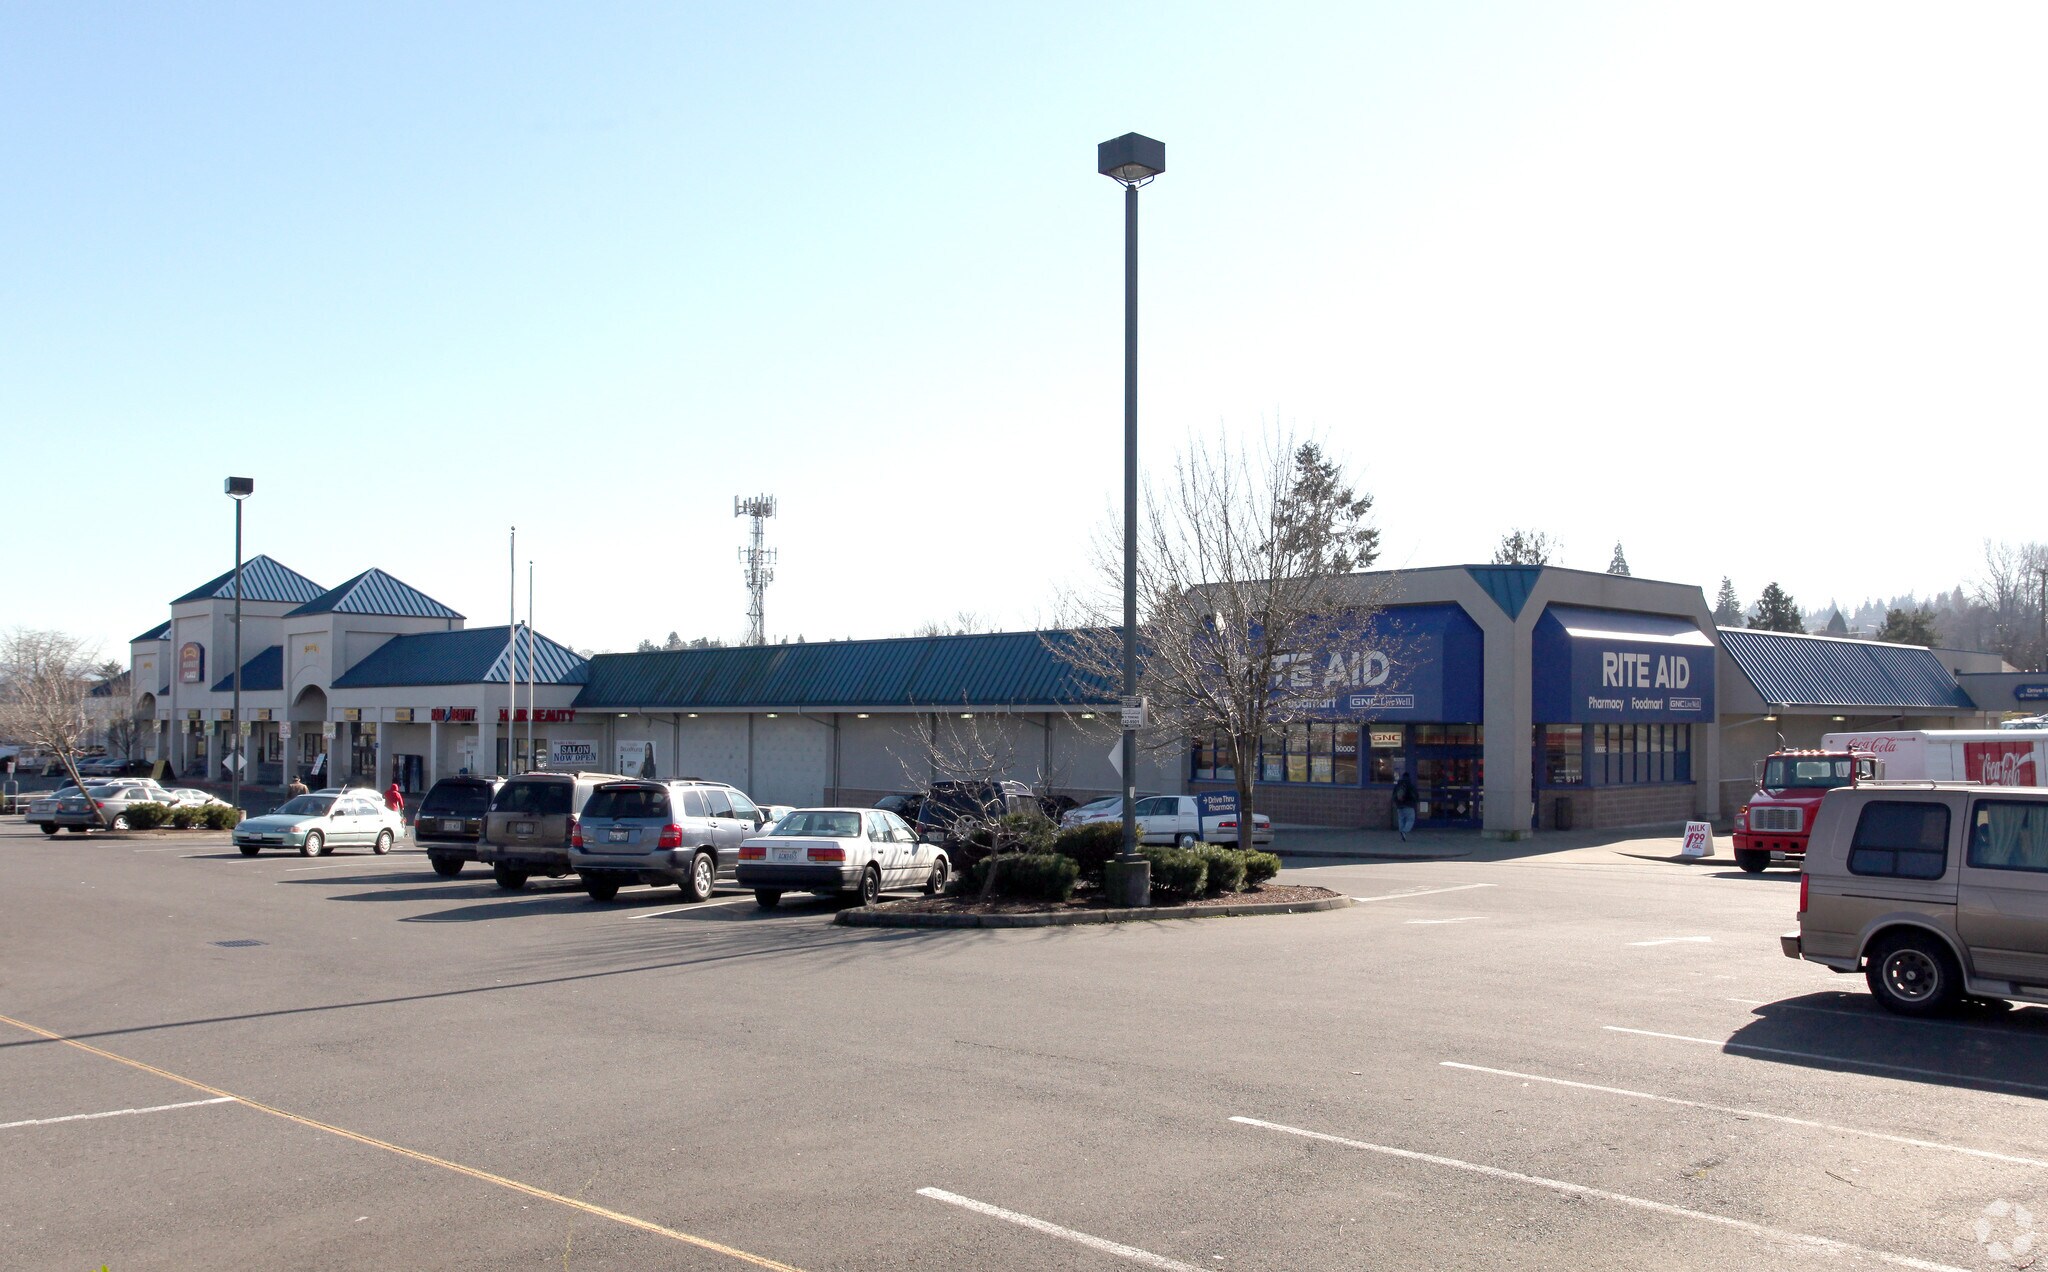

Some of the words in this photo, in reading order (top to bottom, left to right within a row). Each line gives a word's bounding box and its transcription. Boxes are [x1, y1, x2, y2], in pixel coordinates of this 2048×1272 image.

[1322, 650, 1390, 687] AID
[1603, 652, 1650, 688] RITE
[1655, 655, 1690, 689] AID
[1275, 696, 1337, 709] oodmart
[1588, 696, 1624, 712] Pharmacy
[1632, 697, 1663, 710] Foodmart
[1670, 700, 1685, 708] GNC
[532, 709, 576, 722] BEAUTY
[561, 745, 590, 754] SALON
[554, 753, 572, 761] NOW
[575, 753, 597, 761] OPEN
[1208, 796, 1222, 804] Drive
[1222, 795, 1235, 803] Thru
[1208, 803, 1236, 811] Pharmacy
[1688, 824, 1706, 832] MILK
